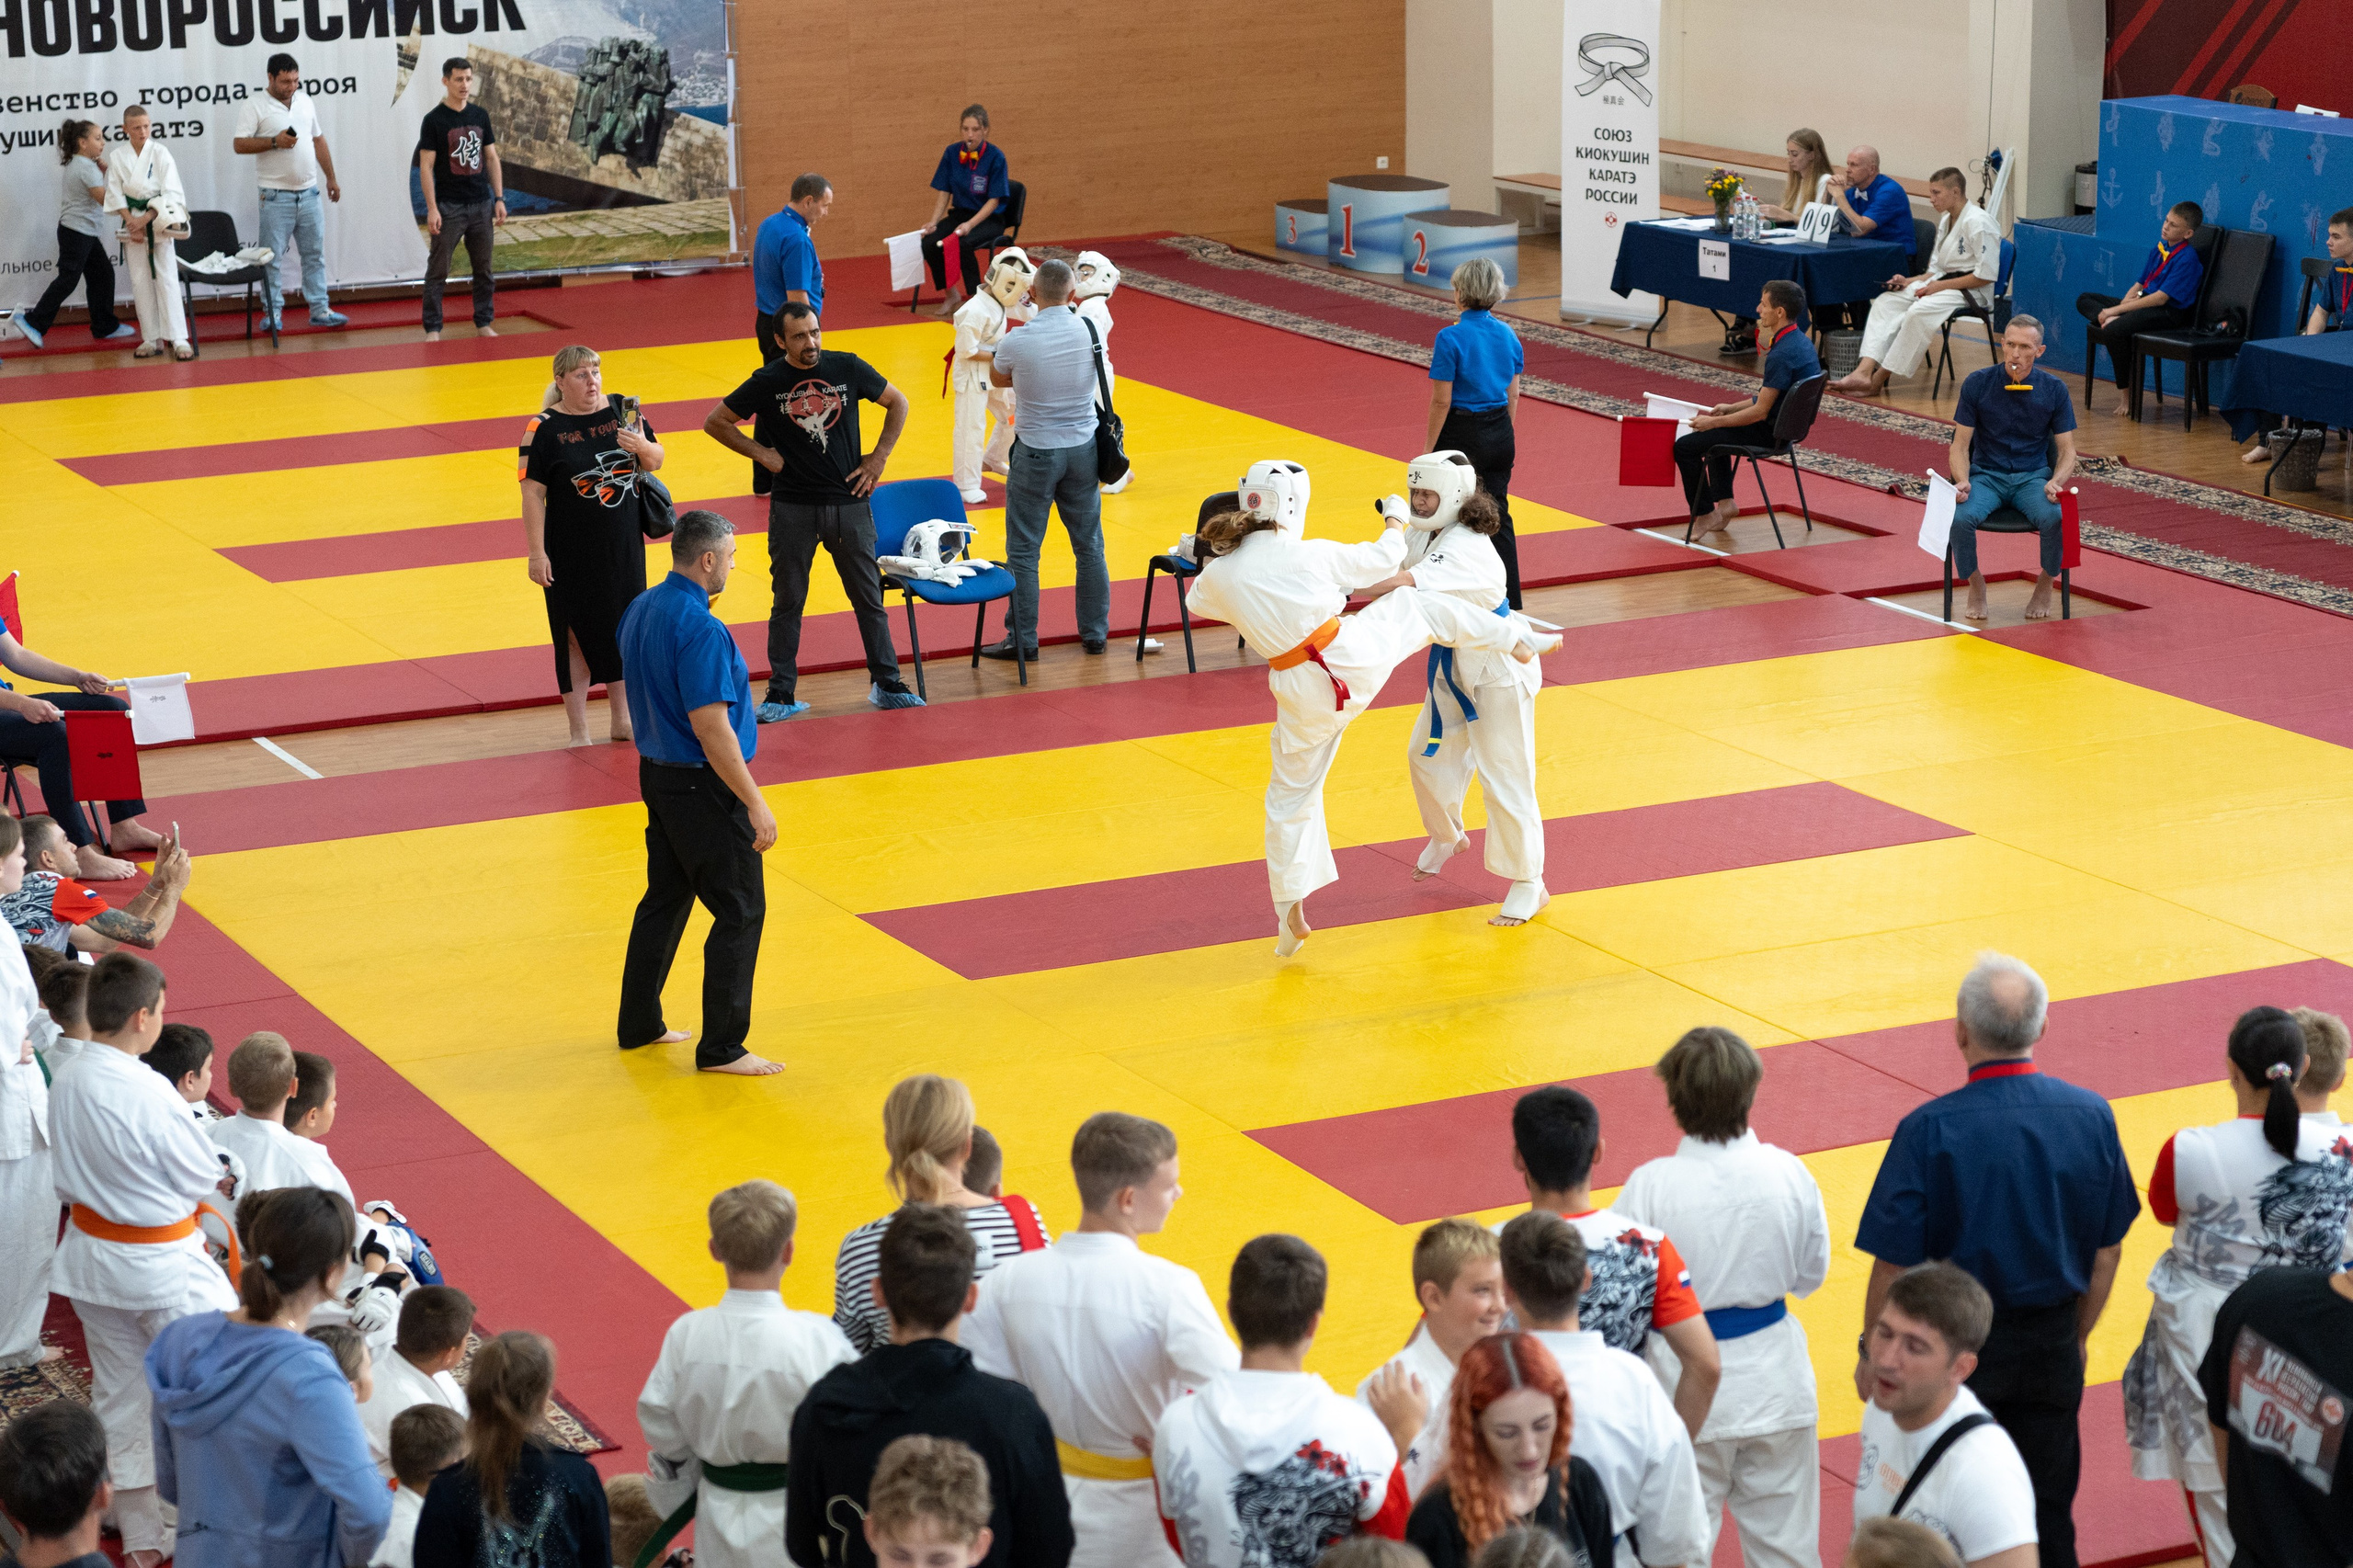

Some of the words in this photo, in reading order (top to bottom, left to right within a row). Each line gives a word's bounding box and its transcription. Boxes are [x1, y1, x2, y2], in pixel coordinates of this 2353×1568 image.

[0, 90, 119, 113] енство
[139, 76, 357, 108] города-роя
[0, 129, 62, 155] уши
[102, 119, 204, 142] каатэ
[1594, 127, 1632, 143] СОЮЗ
[1575, 146, 1650, 165] КИОКУШИН
[1589, 168, 1637, 185] КАРАТЭ
[1586, 187, 1638, 205] РОССИИ
[1287, 215, 1297, 244] 3
[1340, 204, 1356, 256] 1
[1412, 231, 1429, 275] 2
[1702, 246, 1726, 257] Татами
[1, 258, 52, 275] льное
[1712, 264, 1717, 273] 1
[775, 389, 816, 401] KYOKUSHIN
[822, 384, 847, 394] KARATE
[557, 429, 585, 445] FOR
[589, 419, 619, 437] YOUR
[2256, 1346, 2287, 1384] XI
[2254, 1400, 2297, 1453] 604
